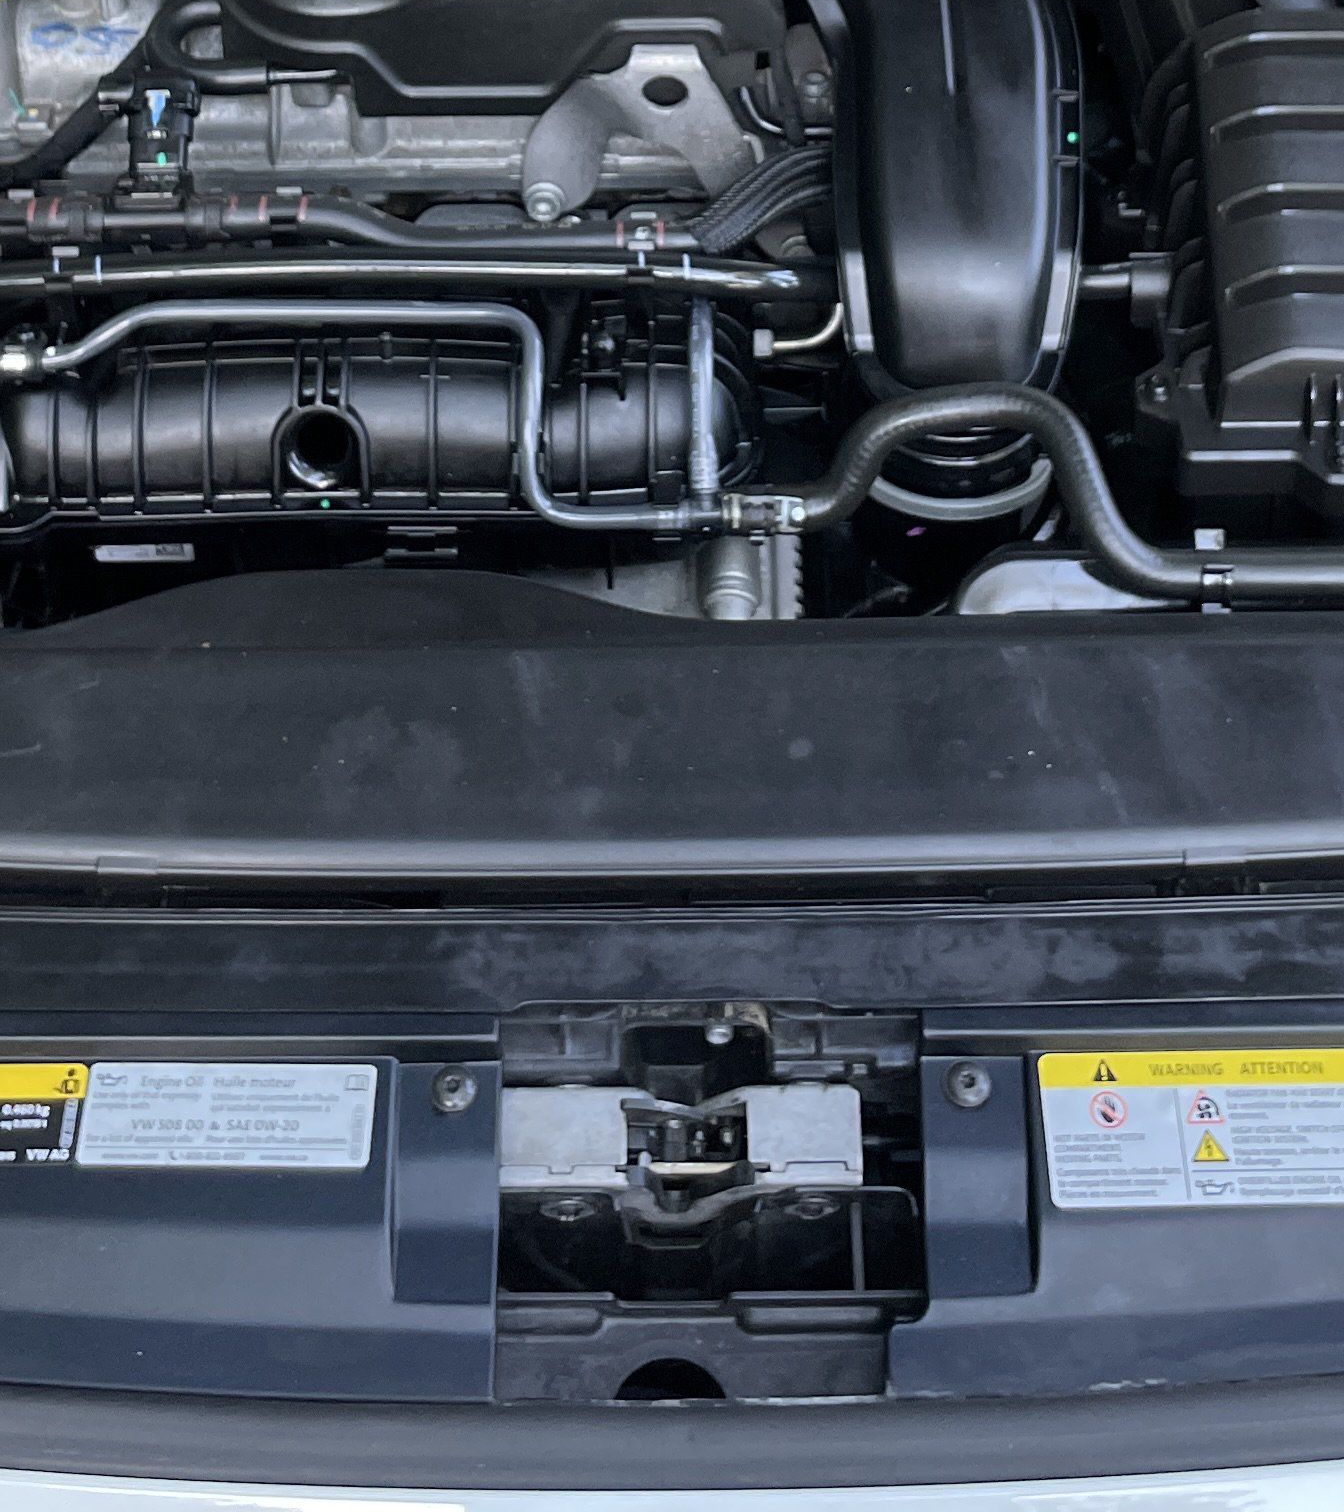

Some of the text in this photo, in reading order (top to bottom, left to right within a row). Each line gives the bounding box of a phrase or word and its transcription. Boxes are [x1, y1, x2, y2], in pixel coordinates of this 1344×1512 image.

[1148, 1061, 1324, 1076] WARNING ATTENTION
[140, 1075, 205, 1090] Engine Oil
[212, 1075, 296, 1088] Huile moteur
[130, 1119, 156, 1130] VW
[226, 1119, 253, 1131] SAE
